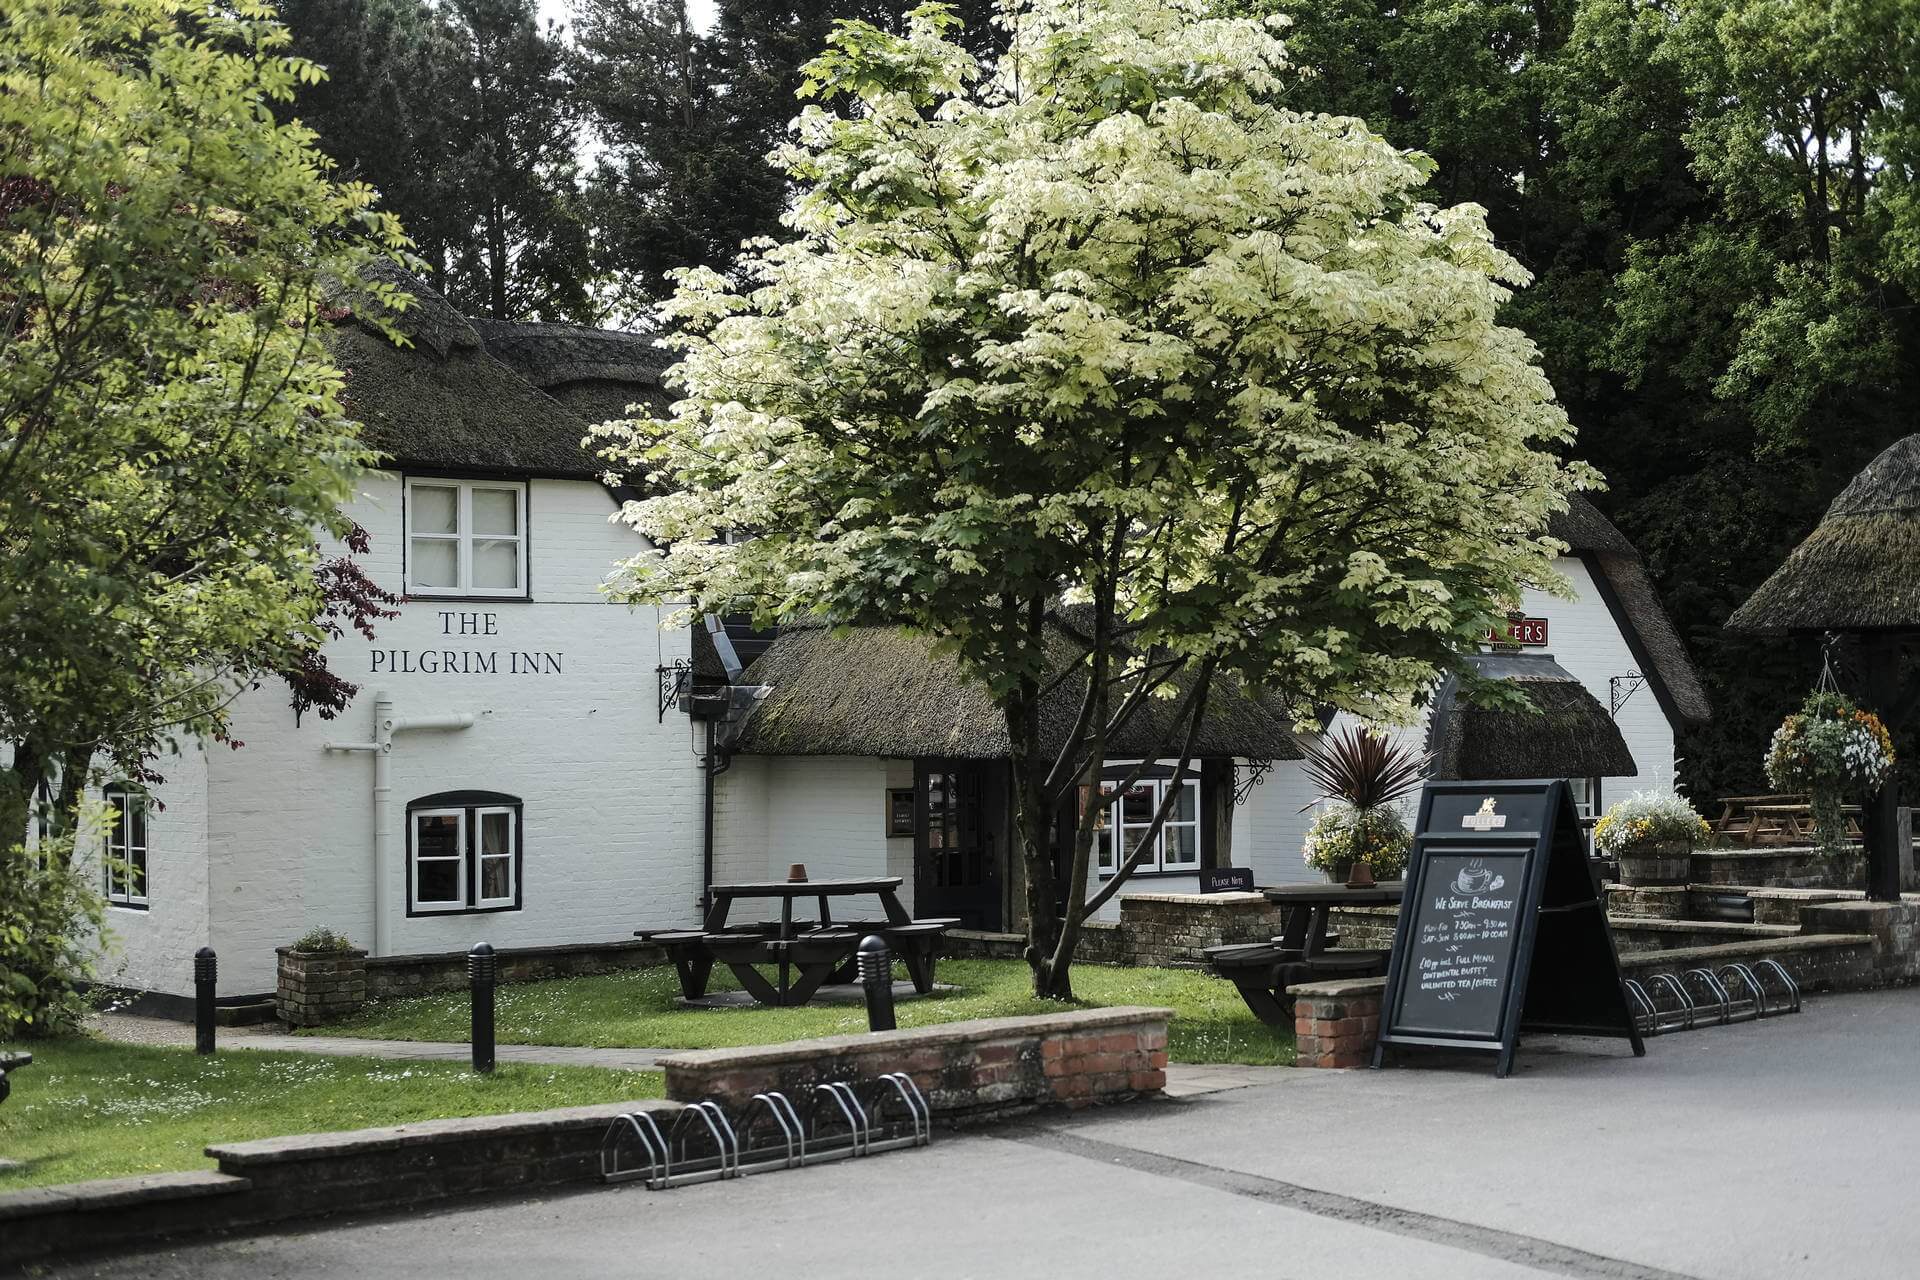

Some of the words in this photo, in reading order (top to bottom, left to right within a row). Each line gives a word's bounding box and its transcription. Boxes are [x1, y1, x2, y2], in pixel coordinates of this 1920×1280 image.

[438, 611, 499, 635] THE
[1480, 622, 1543, 641] UER'S
[369, 650, 499, 674] PILGRIM
[510, 652, 564, 674] INN
